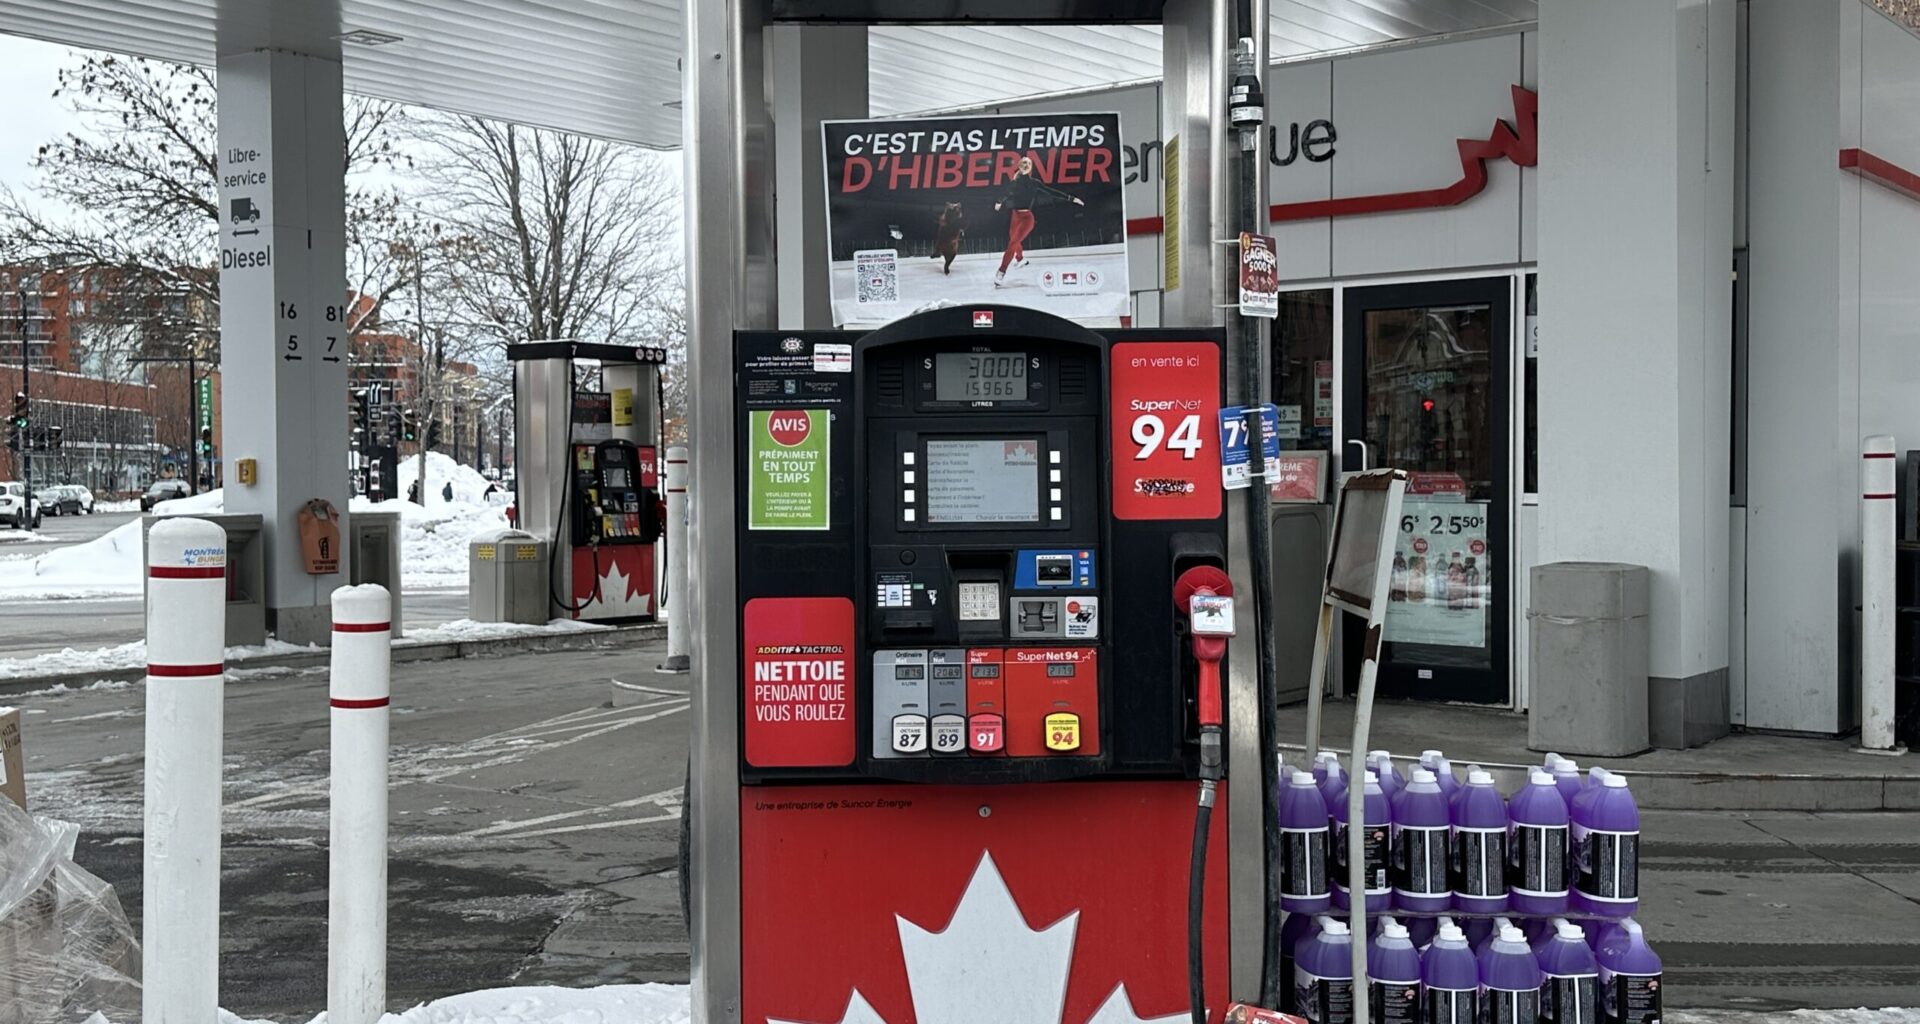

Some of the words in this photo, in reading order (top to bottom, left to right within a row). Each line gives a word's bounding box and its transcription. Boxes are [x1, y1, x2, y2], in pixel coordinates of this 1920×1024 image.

[844, 132, 925, 155] C'EST
[931, 130, 983, 153] PAS
[990, 124, 1105, 150] L'TEMPS
[228, 148, 261, 164] Libre-
[842, 147, 1113, 193] D'HIBERNER
[224, 170, 267, 188] service
[222, 245, 270, 269] Diesel
[1244, 247, 1276, 268] GAGNER
[287, 303, 297, 319] 6
[325, 305, 336, 322] 8
[287, 335, 298, 351] 5
[325, 337, 336, 351] 7
[1131, 357, 1147, 368] en
[1150, 355, 1183, 367] vente
[1186, 355, 1200, 367] ici
[1130, 399, 1202, 413] SuperNet
[772, 418, 807, 432] AVIS
[1130, 413, 1203, 460] 94
[759, 449, 819, 459] PRÉPAIMENT
[640, 463, 653, 473] 94
[763, 461, 779, 472] EN
[782, 461, 816, 472] TOUT
[769, 473, 810, 483] TEMPS
[758, 646, 795, 654] ADDITIF
[802, 646, 843, 654] TACTROL
[755, 661, 845, 681] NETTOIE
[755, 684, 816, 701] PENDANT
[819, 684, 845, 701] QUE
[755, 704, 791, 721] VOUS
[795, 704, 845, 721] ROULEZ
[899, 734, 921, 747] 87
[937, 734, 959, 747] 89
[976, 732, 995, 746] 91
[1052, 732, 1074, 745] 94
[756, 801, 775, 811] Une
[777, 801, 825, 812] entreprise
[827, 800, 839, 809] de
[841, 800, 874, 809] Suncor
